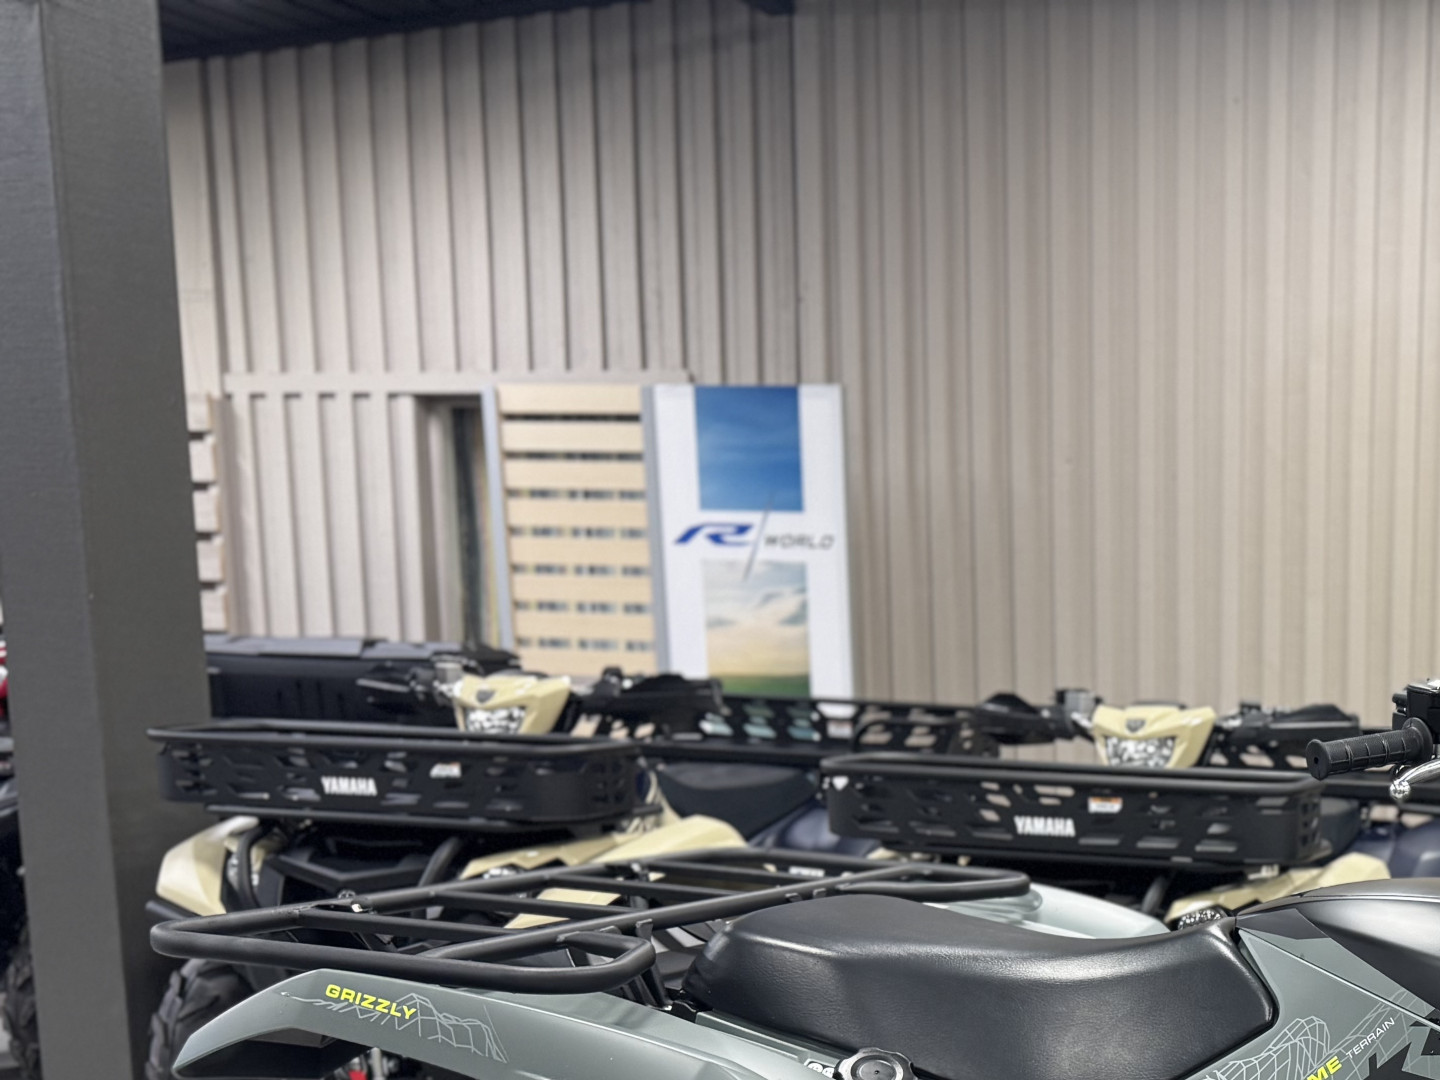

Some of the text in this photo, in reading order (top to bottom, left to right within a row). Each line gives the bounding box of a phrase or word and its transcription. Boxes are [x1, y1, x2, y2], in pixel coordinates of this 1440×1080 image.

[764, 533, 835, 549] WORLD
[320, 775, 378, 797] YAMAHA
[1013, 815, 1076, 837] YAMAHA
[325, 984, 417, 1020] GRIZZLY
[1345, 1016, 1397, 1059] TERRAIN
